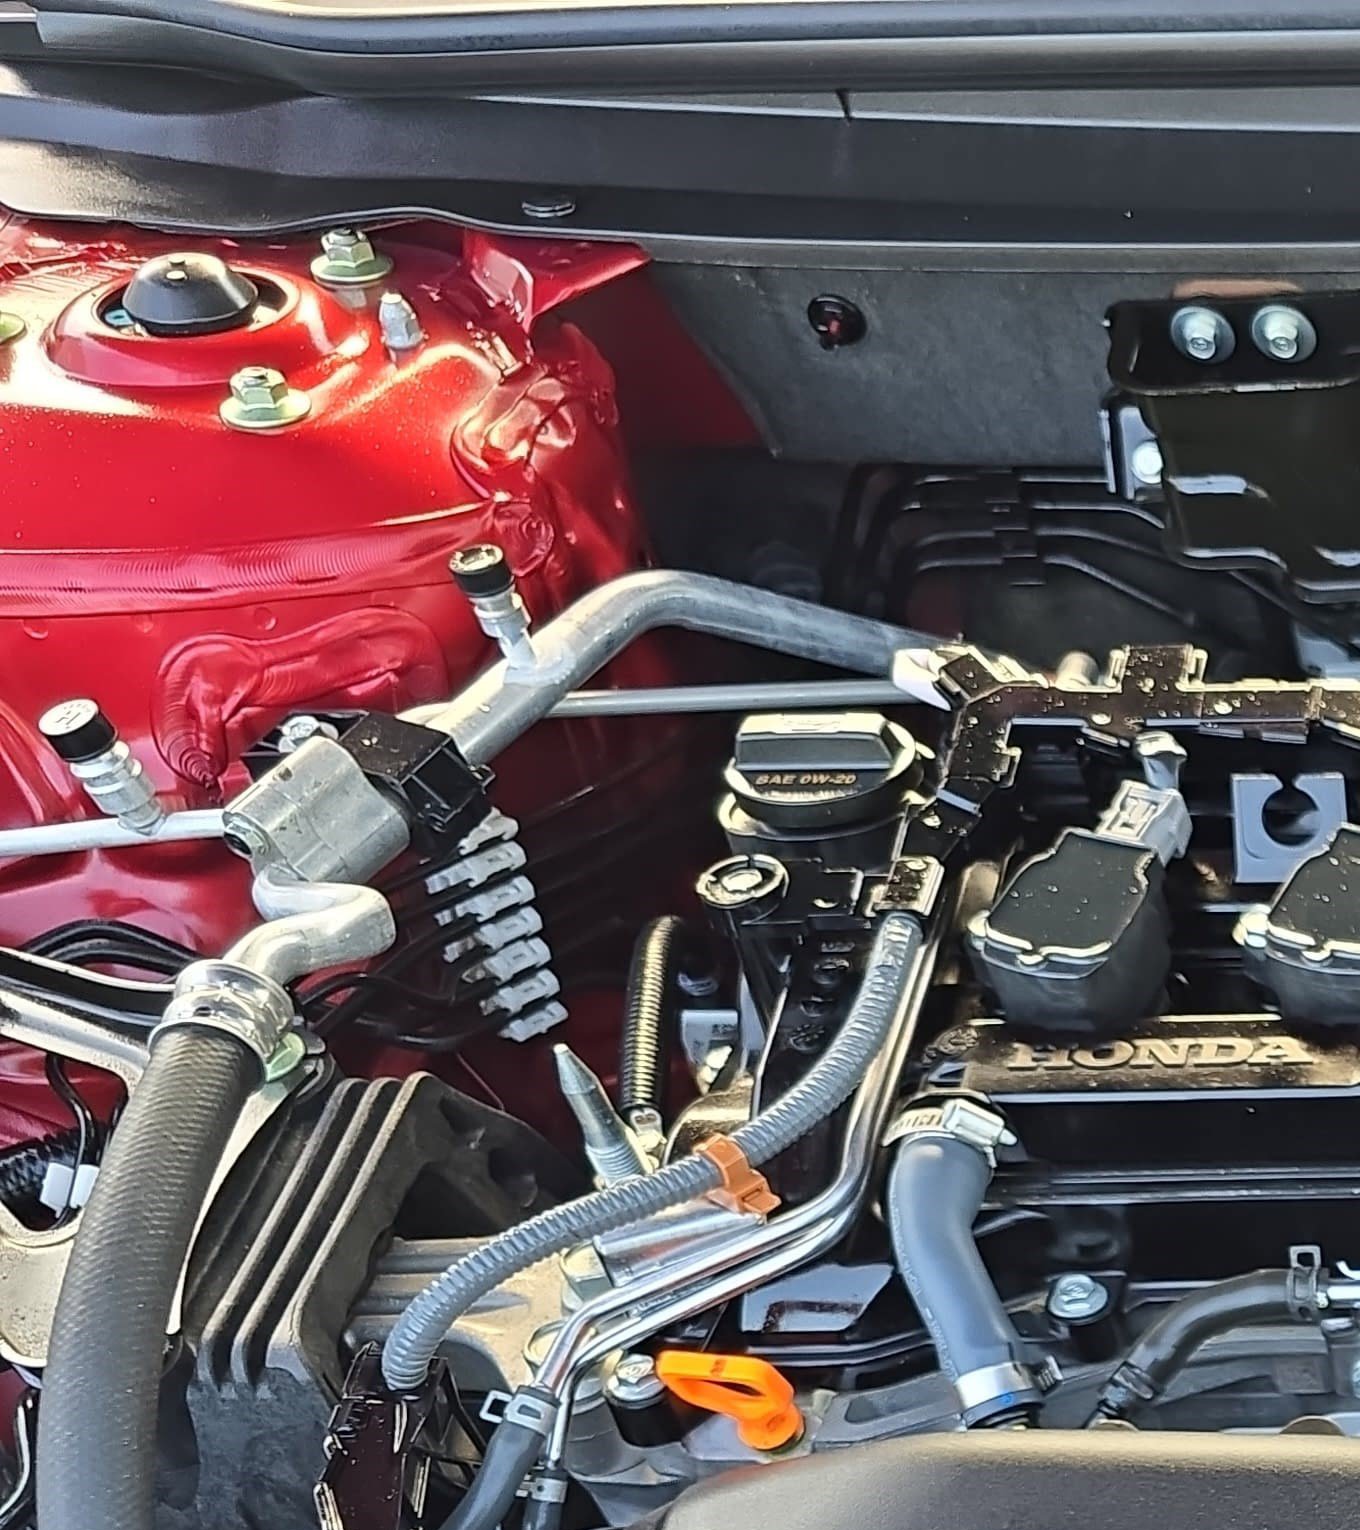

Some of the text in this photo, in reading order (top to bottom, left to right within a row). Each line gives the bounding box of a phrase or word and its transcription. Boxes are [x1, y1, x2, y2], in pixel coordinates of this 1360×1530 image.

[755, 774, 857, 785] SAE 0W-20
[1007, 1035, 1313, 1071] HONDA
